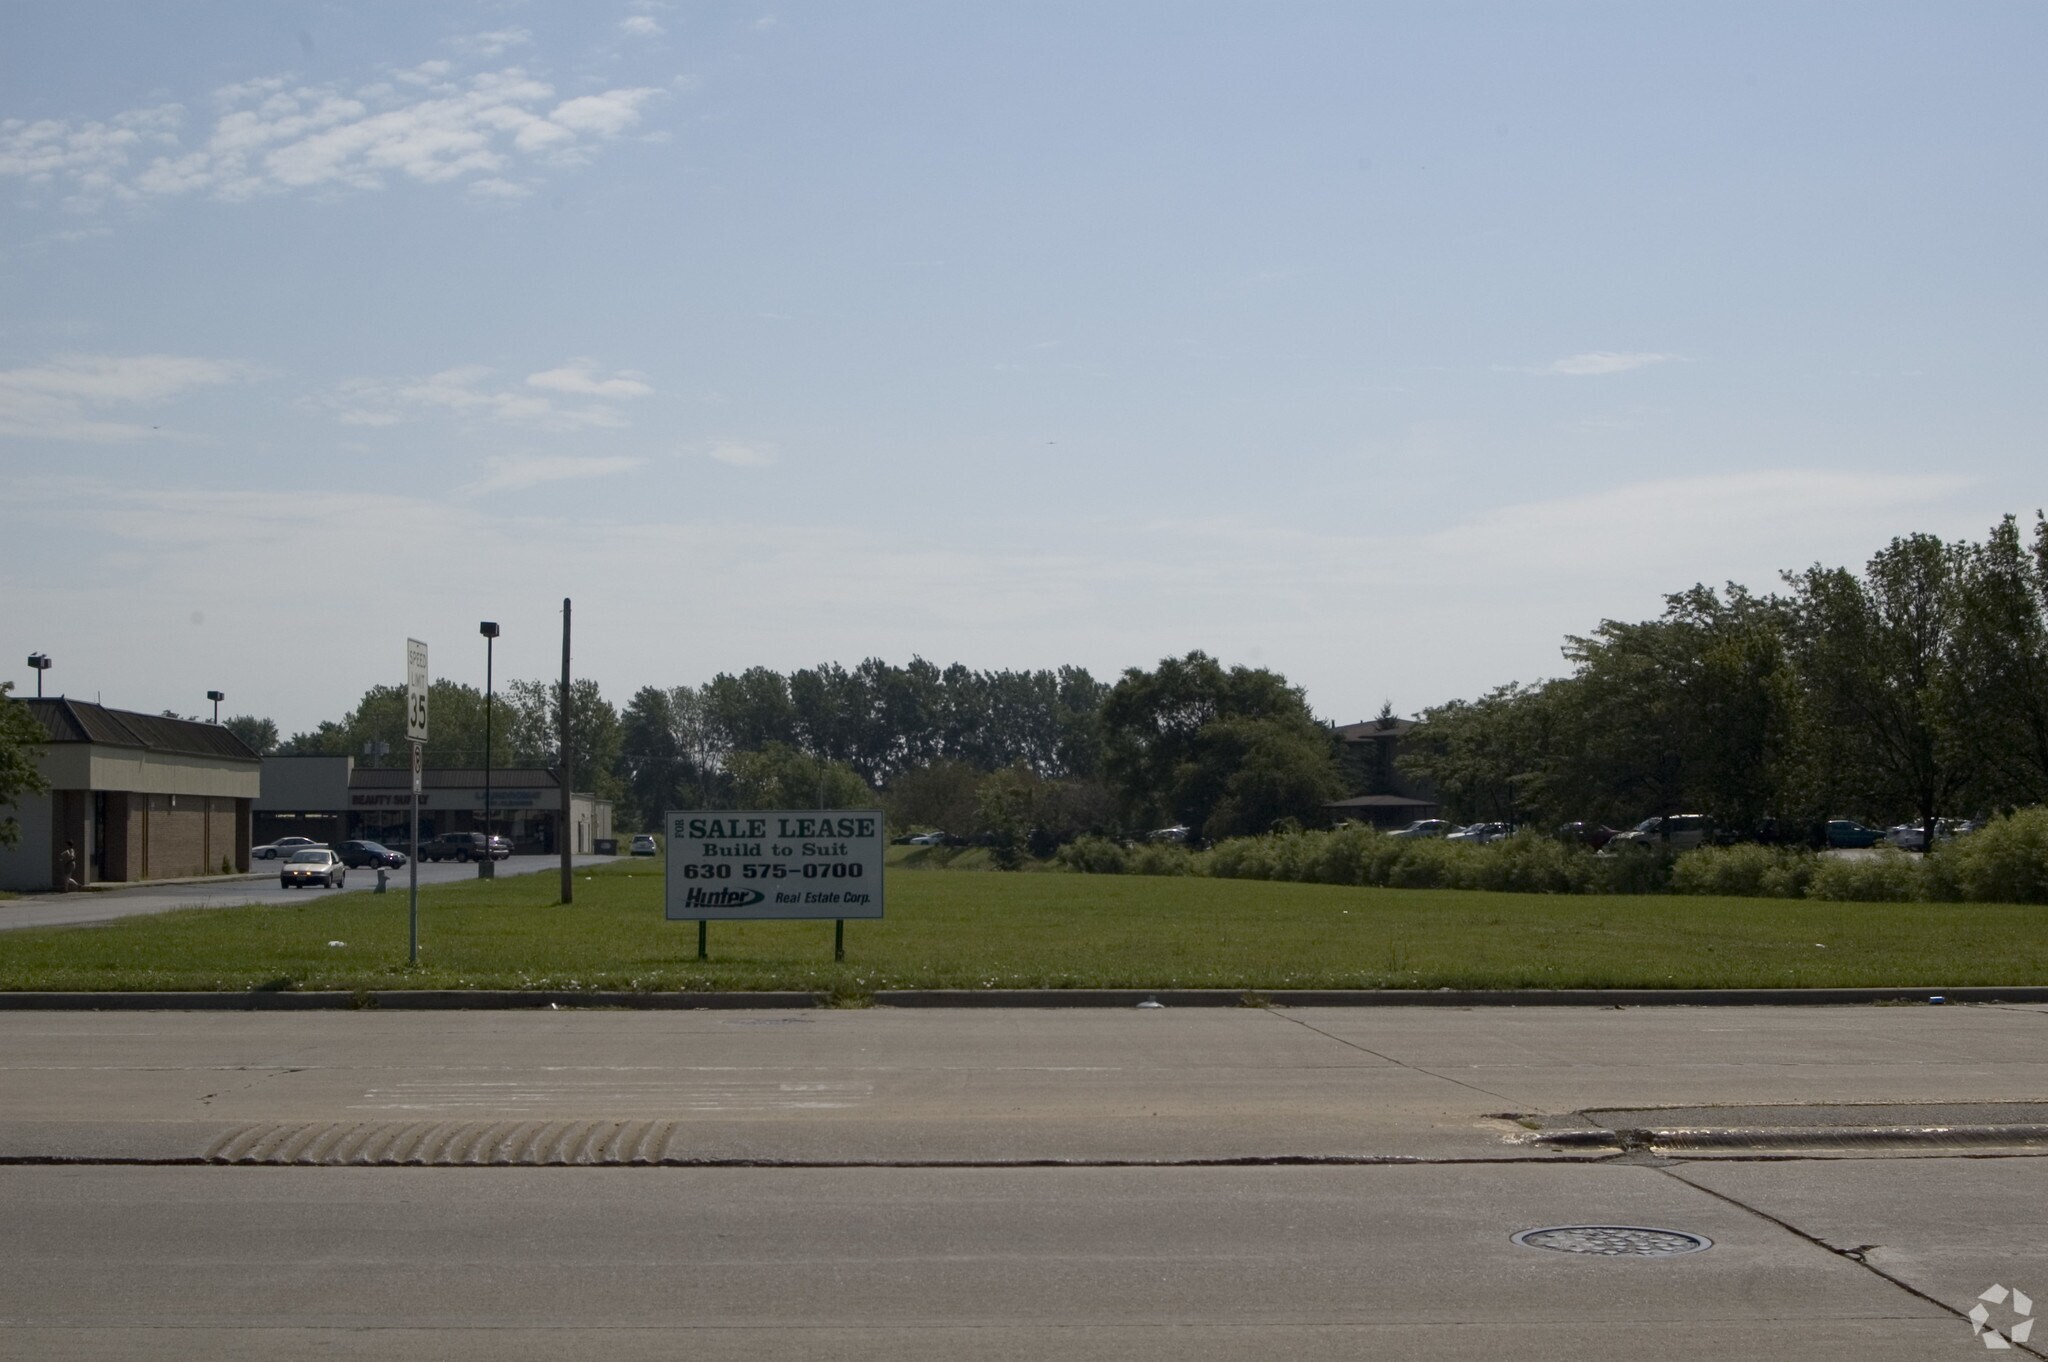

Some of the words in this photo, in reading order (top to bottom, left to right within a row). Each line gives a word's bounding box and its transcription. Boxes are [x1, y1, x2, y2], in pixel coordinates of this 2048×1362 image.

[409, 650, 426, 669] SPEED
[411, 671, 425, 690] LIMIT
[410, 692, 426, 730] 35
[352, 795, 392, 805] BEAUTY
[675, 819, 685, 838] FOR
[689, 818, 766, 839] SALE
[778, 818, 875, 838] LEASE
[702, 843, 762, 857] Build
[772, 844, 793, 856] to
[802, 843, 848, 856] Suit
[684, 864, 731, 879] 630
[742, 863, 863, 879] 575-0700
[685, 887, 750, 908] Hunter
[775, 892, 801, 903] Real
[805, 891, 840, 903] Estate
[843, 892, 871, 906] Corp.
